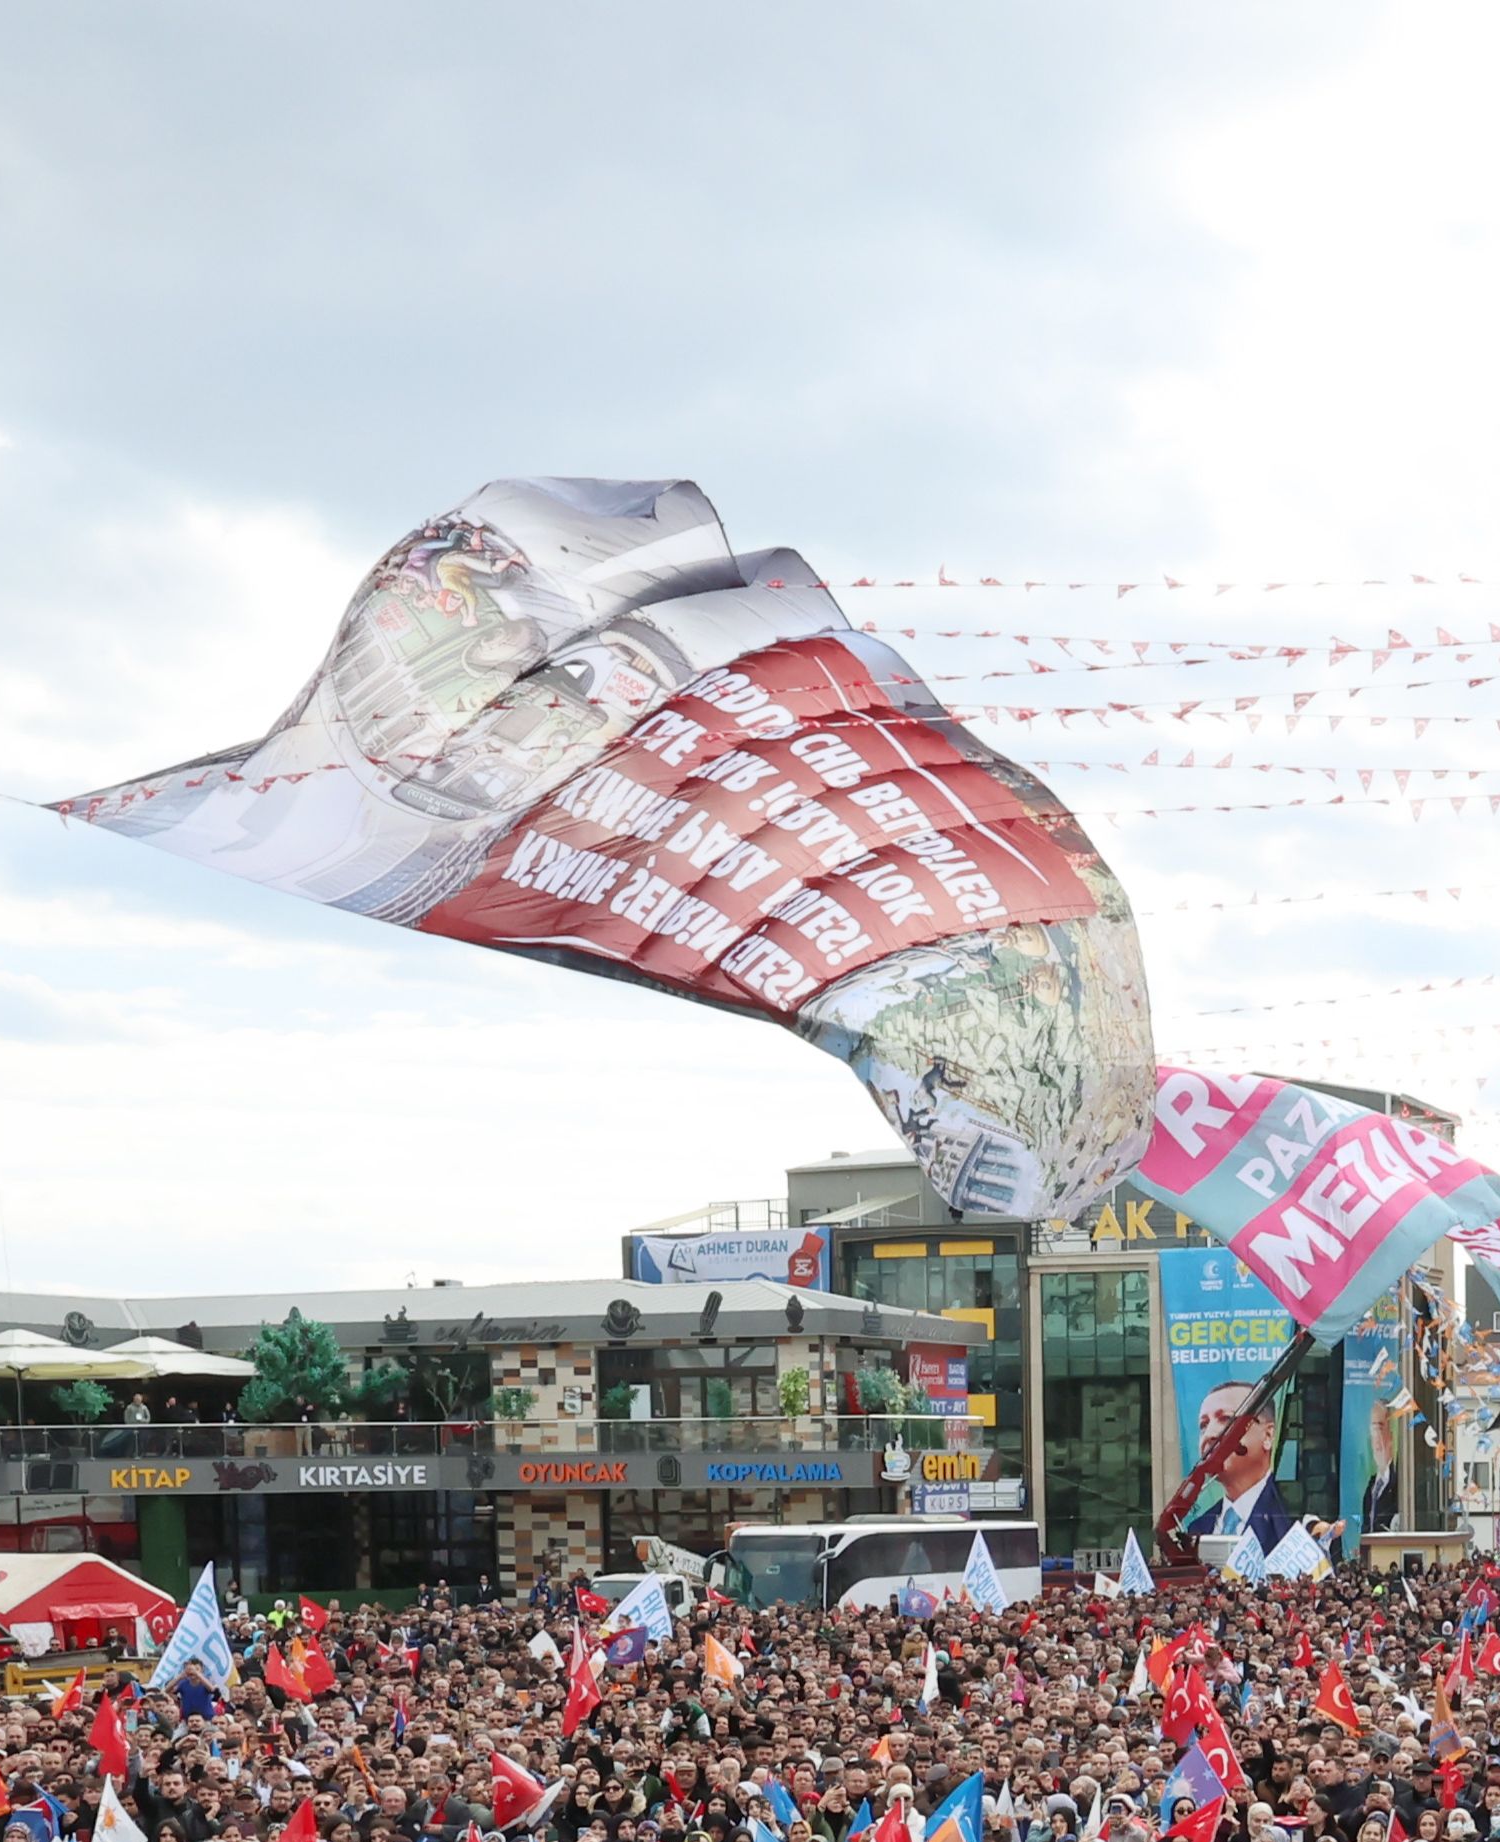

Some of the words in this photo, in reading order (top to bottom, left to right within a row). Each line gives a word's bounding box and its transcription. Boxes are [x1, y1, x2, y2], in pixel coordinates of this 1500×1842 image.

[1091, 1200, 1157, 1241] AK
[696, 1241, 742, 1257] AHMET
[746, 1239, 789, 1254] DURAN
[1169, 1318, 1289, 1346] GERÇEK
[110, 1465, 192, 1491] KİTAP
[299, 1459, 428, 1488] KIRTASİYE
[518, 1460, 629, 1485] OYUNCAK
[706, 1461, 843, 1482] KOPYALAMA
[922, 1450, 982, 1483] emin
